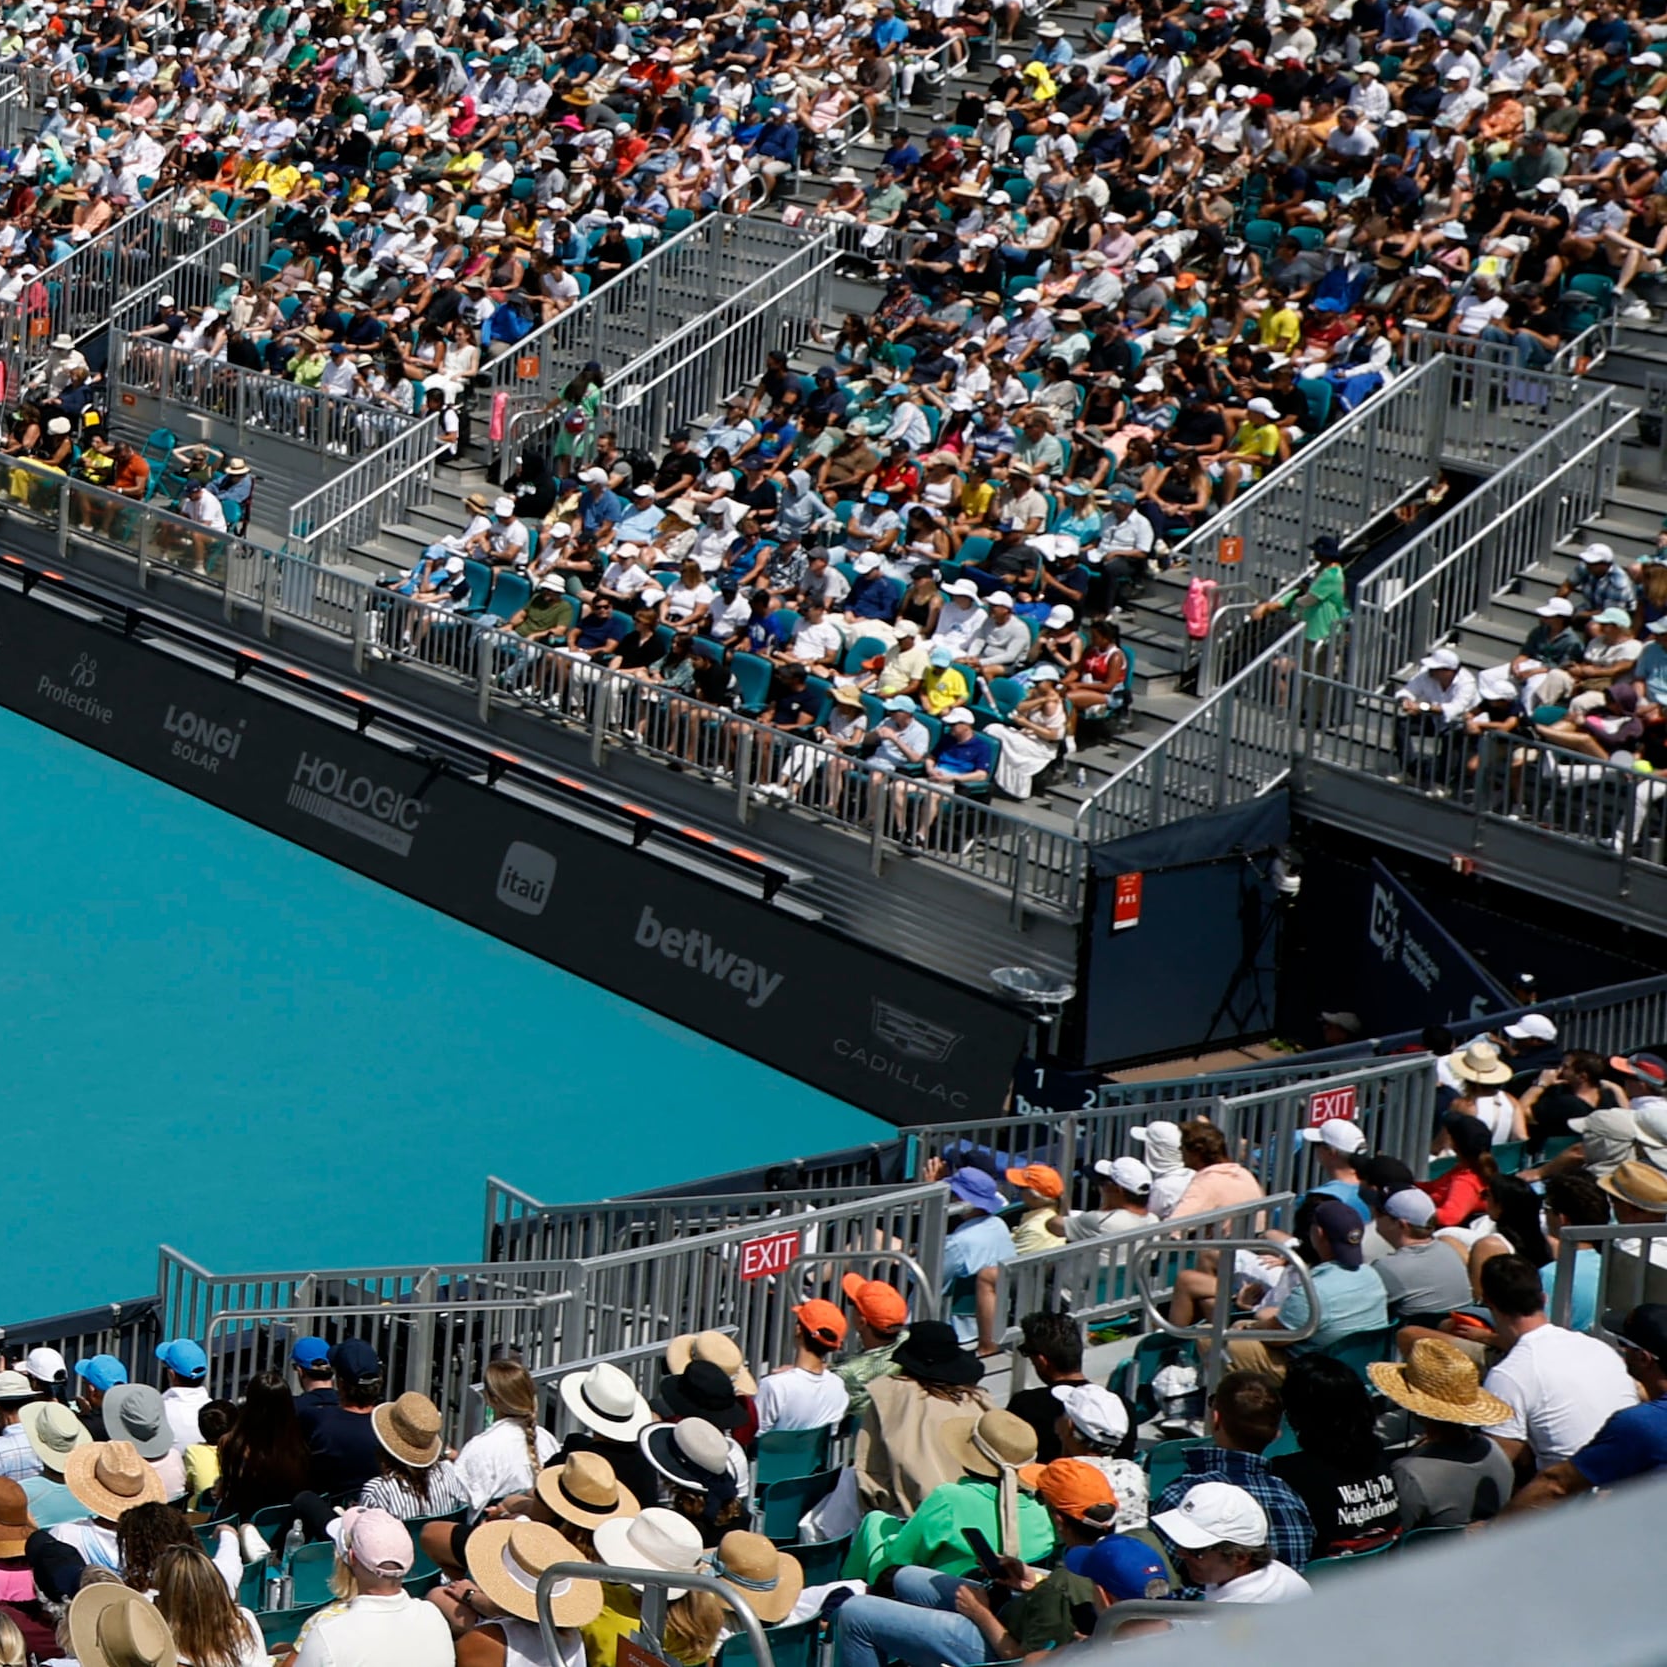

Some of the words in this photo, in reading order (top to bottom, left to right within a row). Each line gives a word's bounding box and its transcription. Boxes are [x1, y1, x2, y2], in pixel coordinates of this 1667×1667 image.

[37, 675, 114, 725] Protective
[171, 740, 220, 774] SOLAR
[293, 752, 421, 831] HOLOGIC
[503, 866, 545, 904] itaú
[635, 905, 784, 1008] betway
[834, 1039, 970, 1109] CADILLAC
[1034, 1068, 1045, 1089] 1
[1082, 1090, 1097, 1110] 2
[1311, 1091, 1353, 1123] EXIT
[743, 1236, 798, 1275] EXIT
[1337, 1483, 1366, 1504] Wake
[1365, 1479, 1381, 1502] Up
[1378, 1474, 1394, 1494] The
